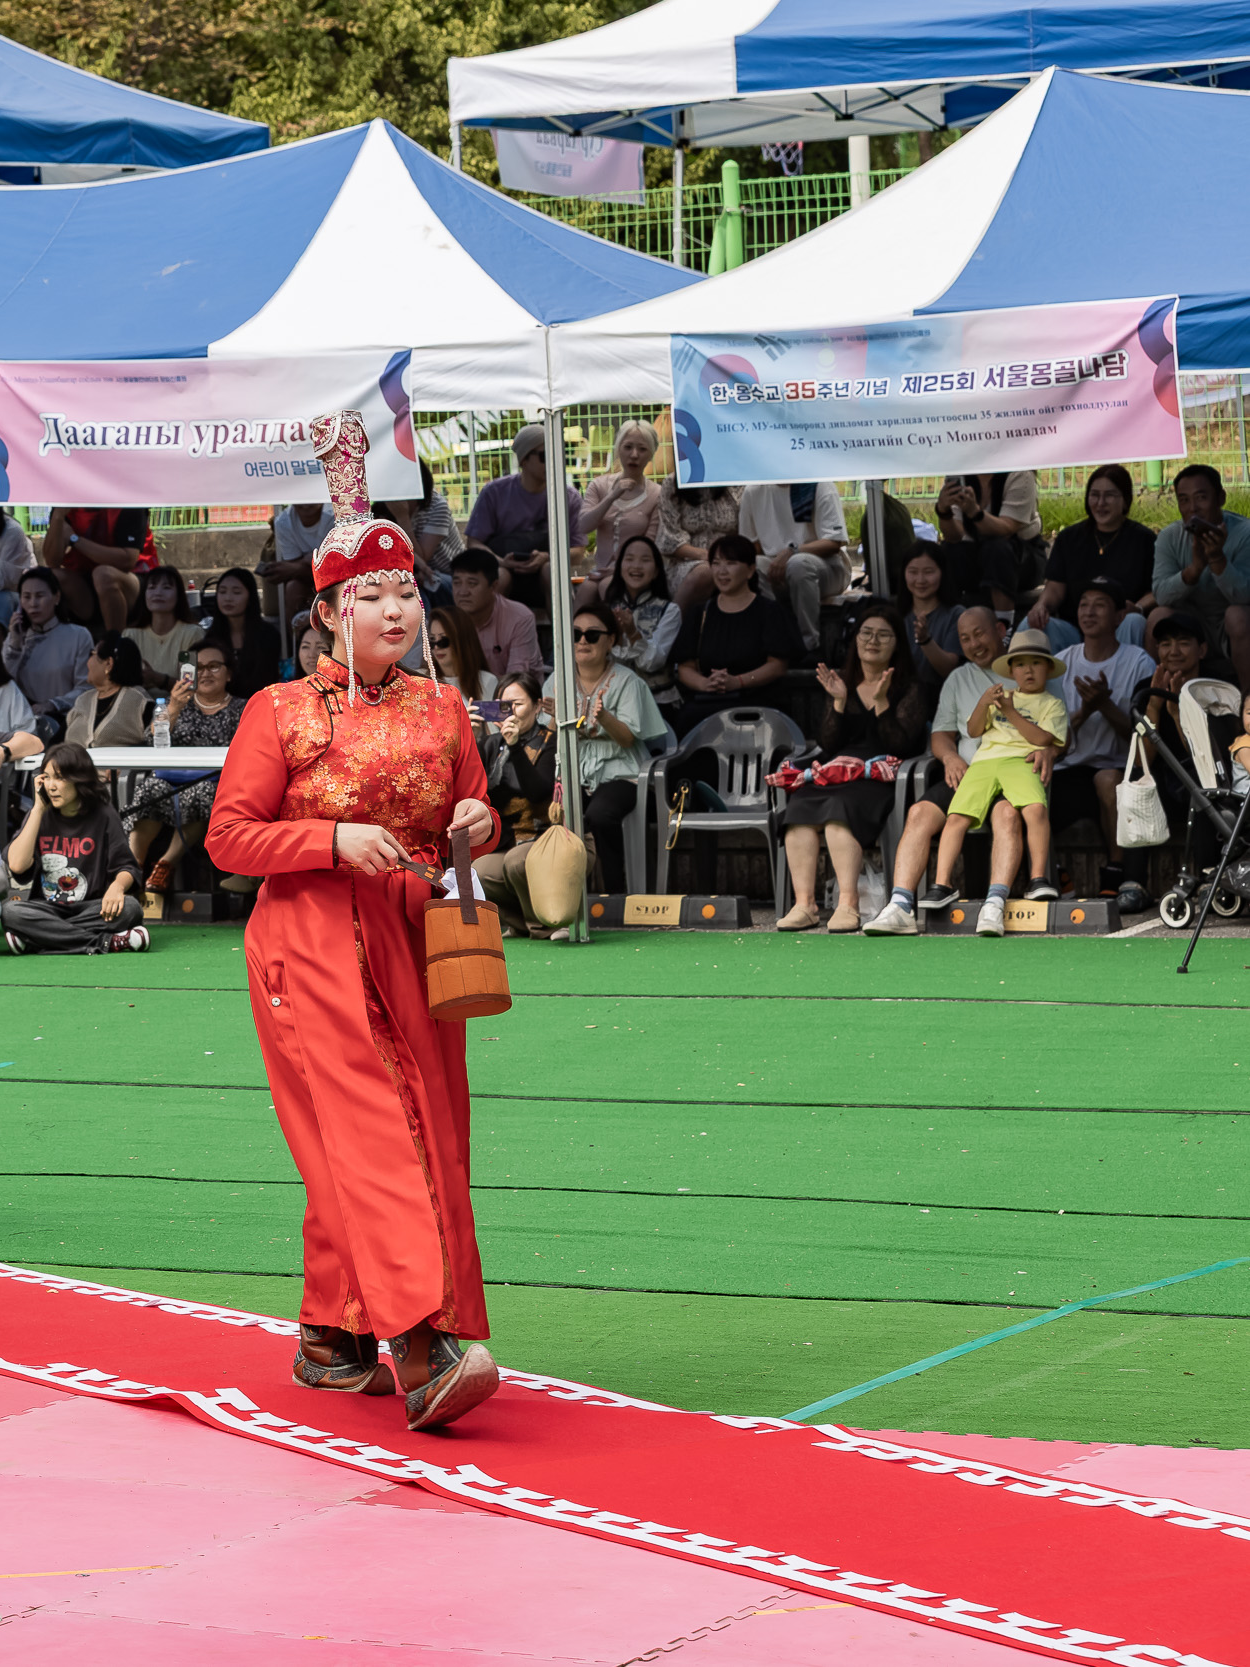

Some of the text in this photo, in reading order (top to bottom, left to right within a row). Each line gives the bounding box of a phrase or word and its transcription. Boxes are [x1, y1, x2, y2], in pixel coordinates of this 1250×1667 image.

[785, 381, 850, 400] 35주년
[855, 379, 888, 397] 기념
[902, 371, 975, 394] 제25회
[983, 352, 1127, 389] 서울몽골나담
[980, 409, 992, 420] 35
[43, 417, 314, 454] Дааганы уралда
[791, 437, 805, 450] 25
[809, 439, 839, 450] дахь
[841, 434, 903, 451] удаагийн
[947, 429, 1001, 443] Монгол
[1005, 425, 1058, 439] наадам
[244, 459, 325, 478] 어린이 말달
[39, 835, 95, 859] ELMO
[636, 905, 669, 915] STOP
[1003, 910, 1035, 920] TOP
